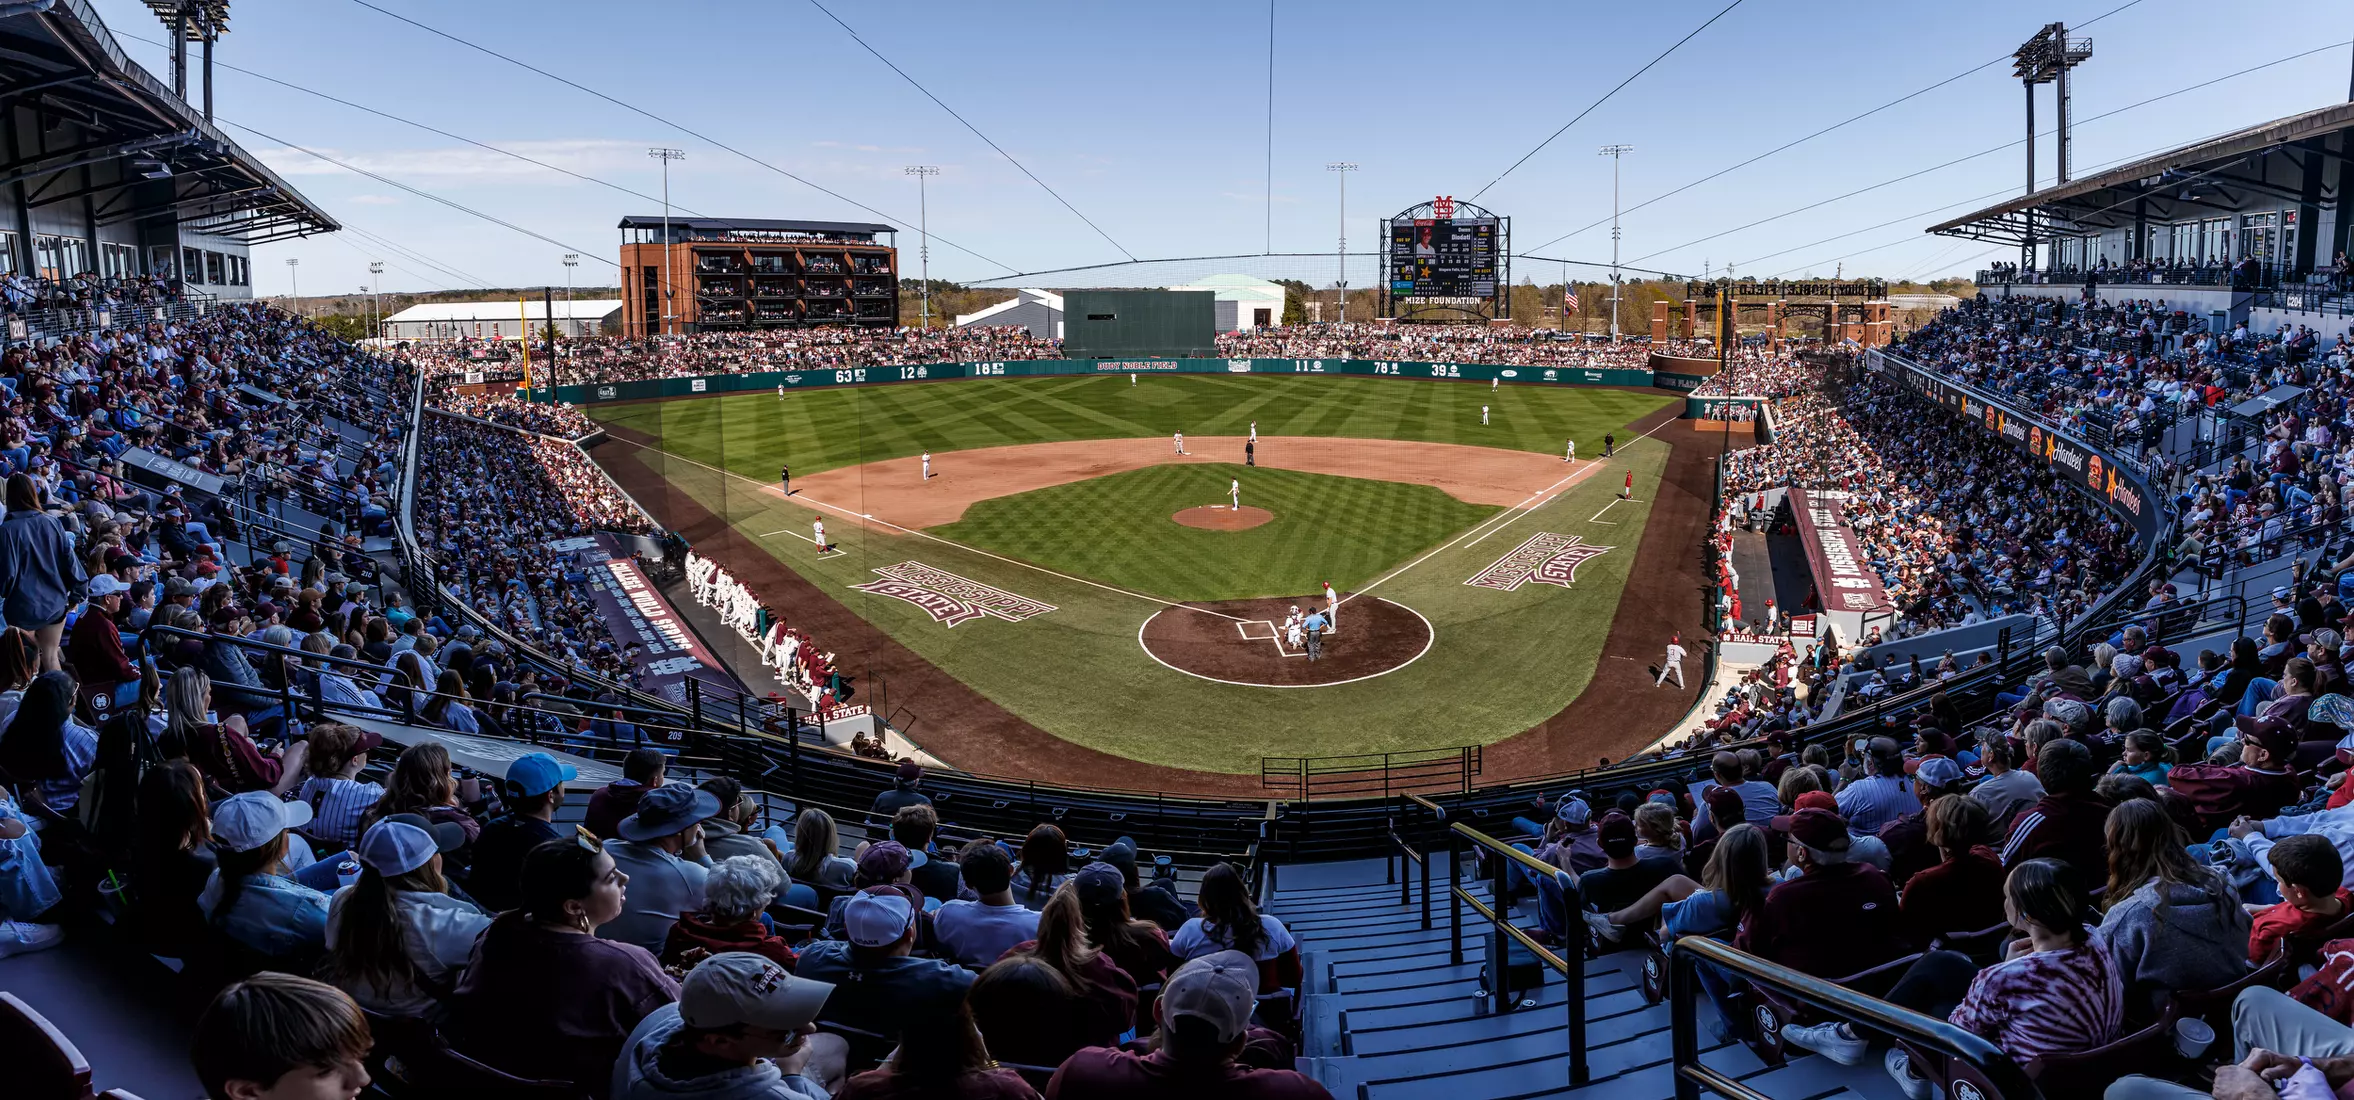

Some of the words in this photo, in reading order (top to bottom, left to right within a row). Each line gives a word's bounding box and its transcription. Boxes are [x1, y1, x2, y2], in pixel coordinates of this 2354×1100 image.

[2287, 294, 2302, 308] C204
[975, 363, 990, 375] 18
[1122, 361, 1151, 370] NOBLE
[1152, 361, 1178, 370] FIELD
[1295, 360, 1308, 371] 11
[1374, 362, 1388, 374] 78
[1432, 364, 1446, 376] 39
[836, 370, 853, 383] 63
[901, 367, 915, 379] 12
[1966, 400, 1983, 419] Hardee's
[2004, 418, 2026, 442] Hardee's
[2052, 442, 2084, 472] Hardee's
[2114, 478, 2142, 516] Hardee's
[1473, 533, 1574, 590] MISSISSIPPI
[1545, 550, 1595, 579] STATE
[361, 570, 372, 578] 210
[886, 563, 1051, 620] MISSISSIPPI
[880, 585, 958, 616] STATE
[629, 590, 666, 617] WORLD
[651, 618, 694, 652] SERIES
[1758, 636, 1782, 644] STAT
[833, 705, 864, 720] STATE
[668, 732, 682, 740] 209
[760, 966, 780, 988] STATE
